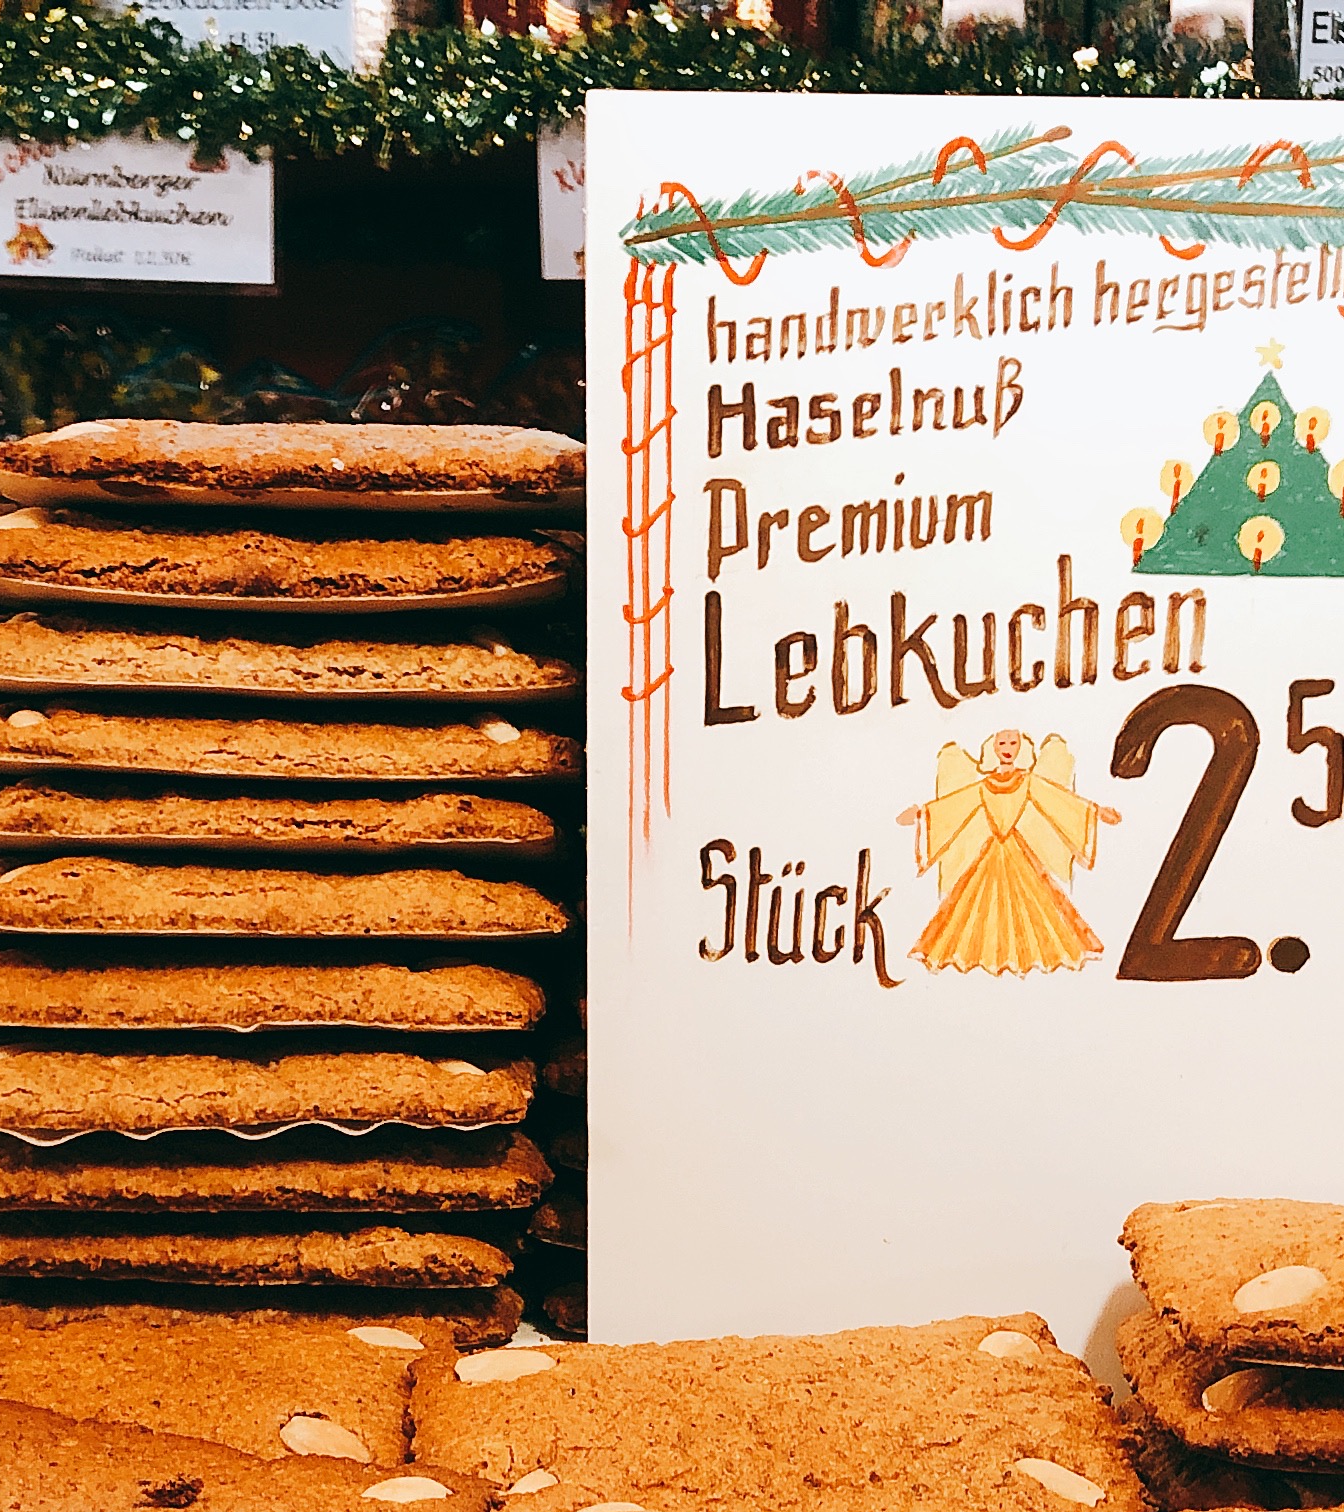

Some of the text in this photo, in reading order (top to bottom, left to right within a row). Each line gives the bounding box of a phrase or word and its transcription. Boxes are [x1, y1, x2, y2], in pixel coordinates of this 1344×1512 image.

[706, 263, 1074, 365] handwerklich
[706, 356, 1024, 459] Haselnuß
[703, 472, 993, 583] Premium
[703, 553, 1208, 727] Lebkuchen
[698, 837, 906, 989] Stück
